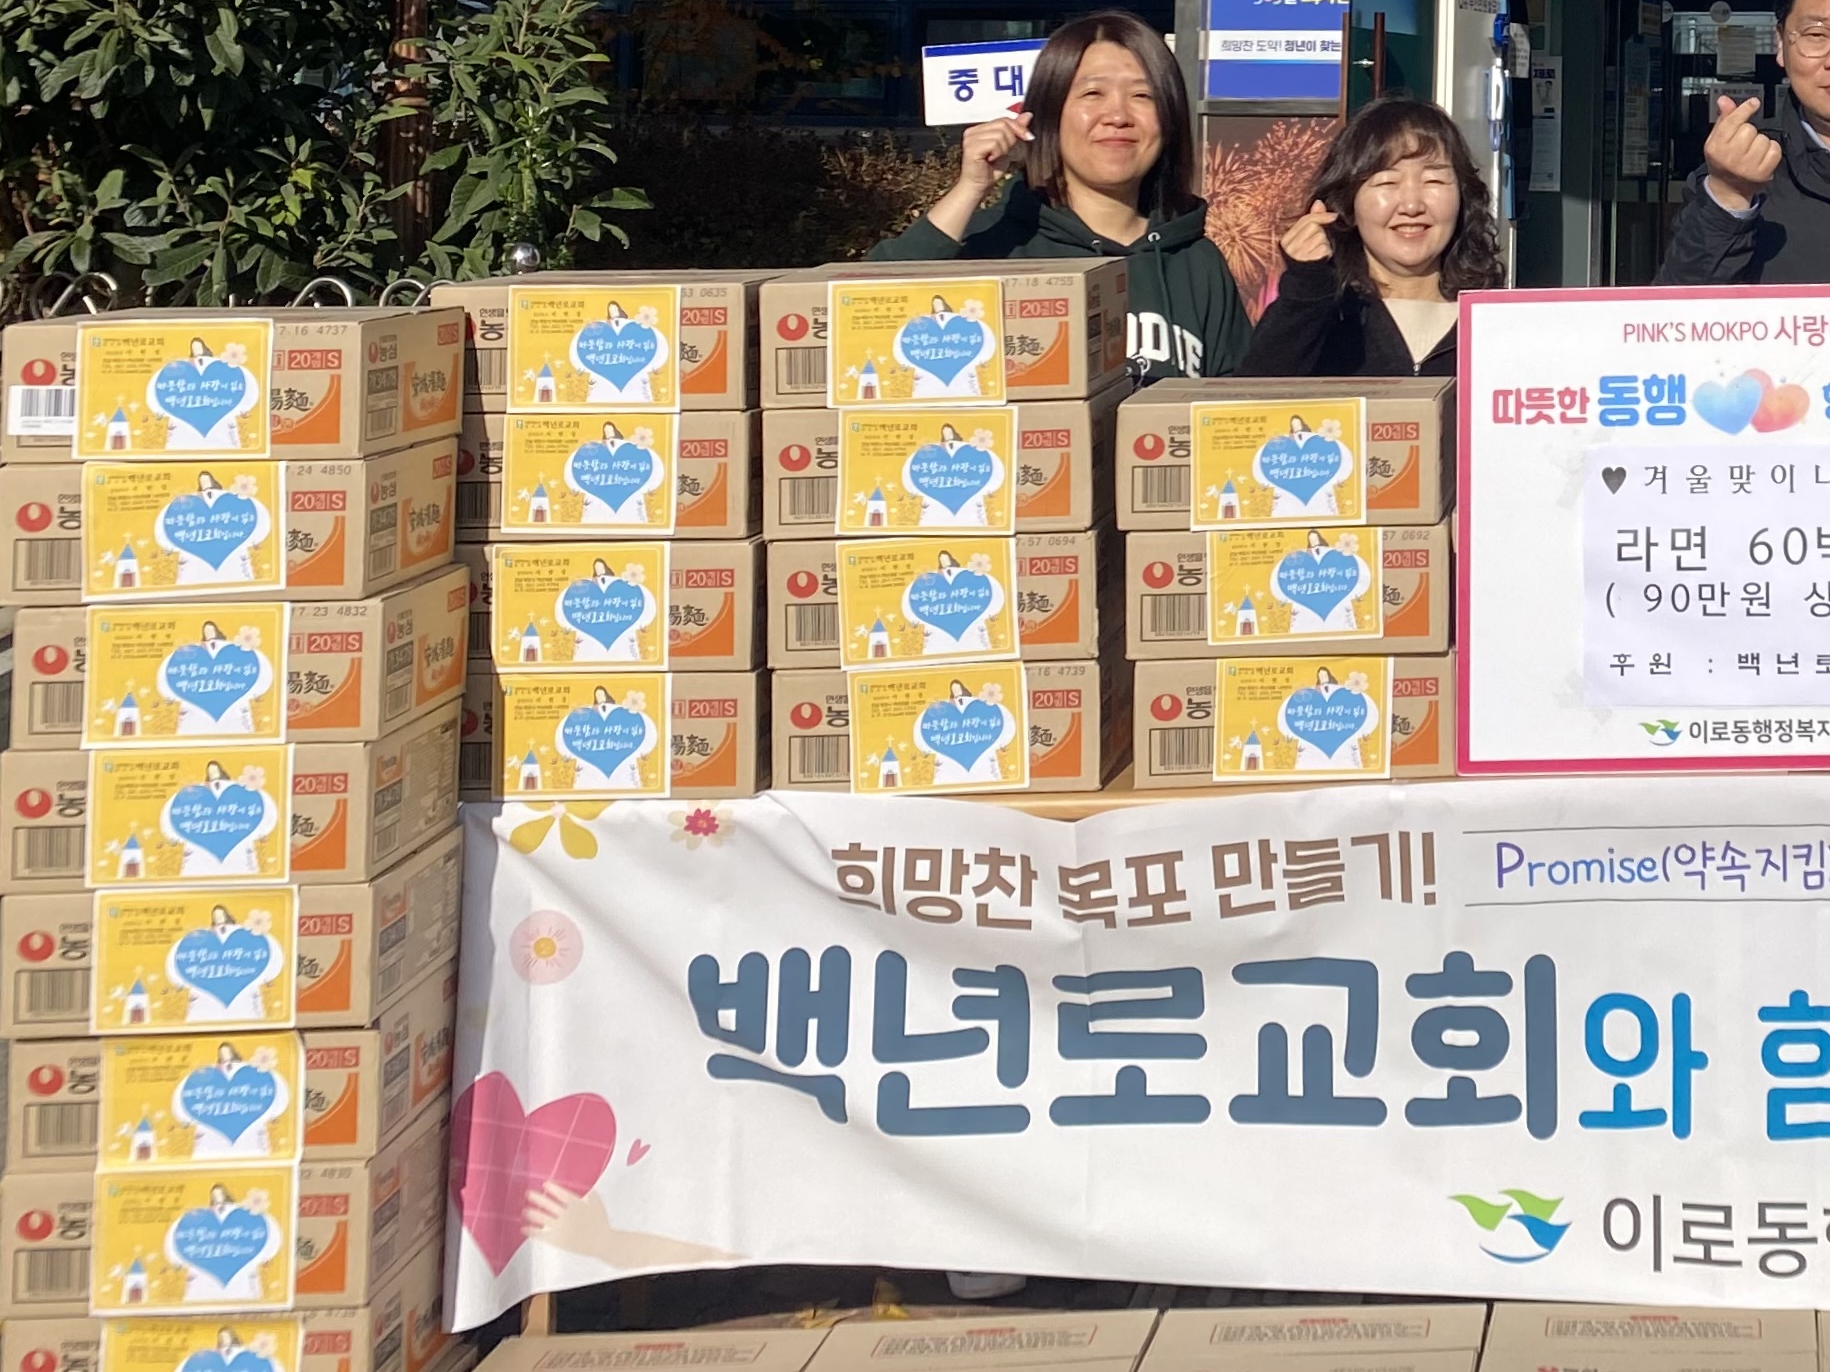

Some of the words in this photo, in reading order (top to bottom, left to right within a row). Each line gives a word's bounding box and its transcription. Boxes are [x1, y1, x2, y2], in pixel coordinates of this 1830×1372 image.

[1220, 41, 1254, 53] 희망찬
[1256, 40, 1282, 53] 도약!
[1283, 40, 1316, 53] 청년이
[1623, 321, 1686, 343] PINK'S
[1691, 321, 1768, 342] MOKPO
[1492, 387, 1590, 425] 따뜻한
[1597, 373, 1687, 428] 동행
[1616, 525, 1707, 573] 라면
[1643, 581, 1771, 617] 90만원
[1609, 652, 1672, 677] 후원
[832, 842, 1038, 930] 희망찬
[1059, 850, 1192, 929] 목포
[1211, 830, 1438, 919] 만들기!
[687, 944, 1710, 1141] 백년로교회와
